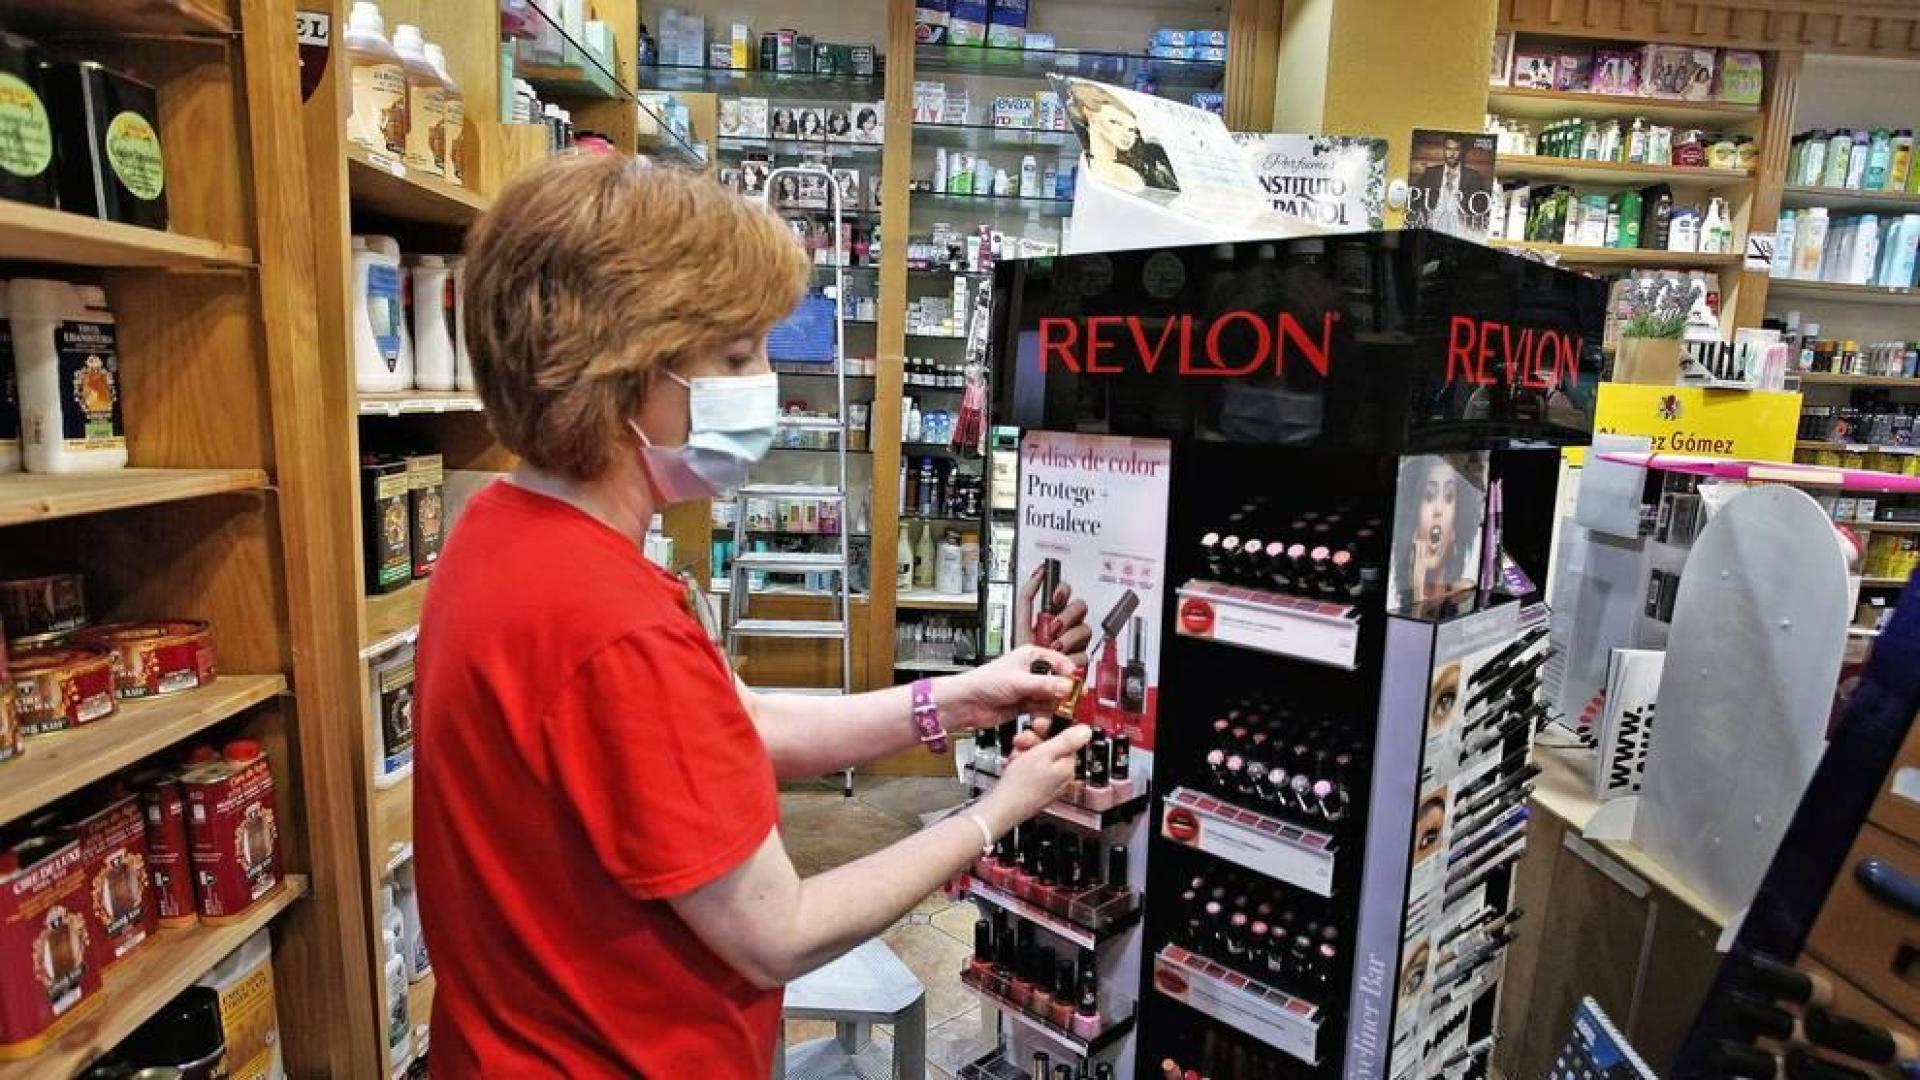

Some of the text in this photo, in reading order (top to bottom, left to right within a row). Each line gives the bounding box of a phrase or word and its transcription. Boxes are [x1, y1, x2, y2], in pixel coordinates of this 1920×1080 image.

[1038, 310, 1336, 377] REVLON
[1446, 314, 1583, 389] REVLON
[1028, 443, 1040, 466] 7
[1081, 448, 1105, 471] de
[1108, 451, 1161, 477] color
[1671, 431, 1735, 455] Gómez
[1026, 474, 1096, 508] Protege
[1025, 504, 1101, 536] fortalece
[1349, 952, 1386, 1080] yeliner Bar
